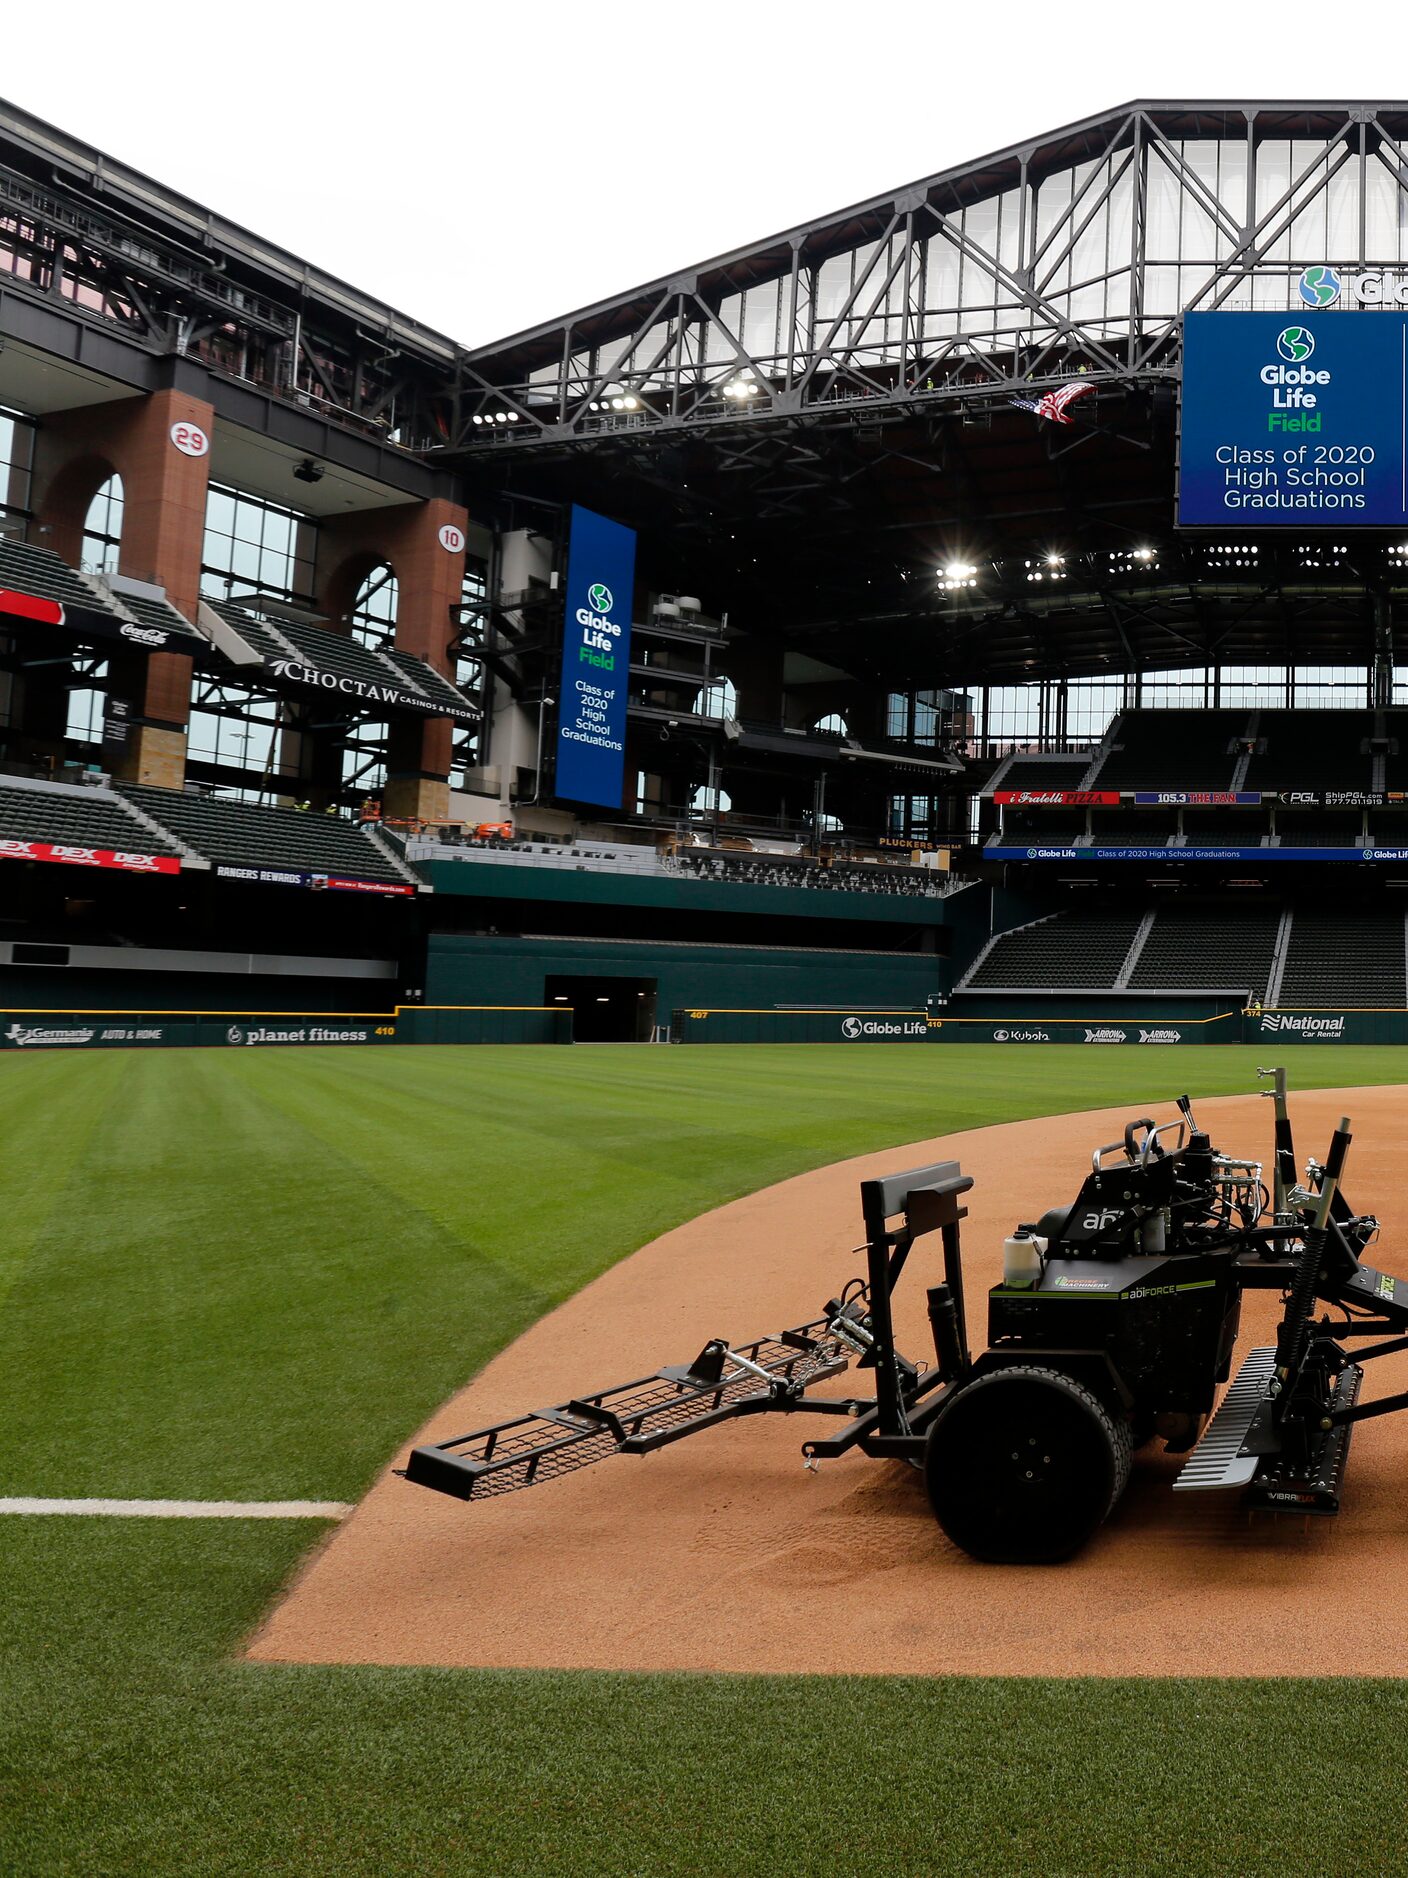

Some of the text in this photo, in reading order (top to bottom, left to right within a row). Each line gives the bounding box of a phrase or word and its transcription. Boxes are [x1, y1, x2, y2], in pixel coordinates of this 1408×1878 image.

[1260, 365, 1331, 385] Globe
[1273, 388, 1317, 408] Life
[1268, 412, 1321, 432] Field
[176, 428, 203, 451] 29
[1216, 445, 1375, 464] Class of 2020
[1225, 467, 1365, 489] High School
[1224, 489, 1366, 508] Graduations
[444, 530, 459, 547] 10
[576, 608, 622, 637] Globe
[583, 628, 613, 652] Life
[579, 647, 615, 671] Field
[284, 662, 400, 703] CHOCTAW
[446, 706, 481, 721] RESORTS
[575, 680, 616, 700] Class of
[580, 694, 608, 710] 2020
[582, 707, 606, 722] High
[576, 718, 611, 736] School
[561, 727, 623, 751] Graduations
[1158, 793, 1187, 803] 105.3
[1290, 792, 1319, 802] PGL
[880, 837, 934, 850] PLUCKERS
[50, 845, 99, 860] DEX
[112, 852, 158, 867] DEX
[1038, 849, 1061, 858] Globe
[1062, 849, 1077, 858] Life
[1098, 850, 1117, 859] Class
[1119, 850, 1127, 859] of
[1128, 850, 1148, 859] 2020
[1149, 850, 1166, 860] High
[1168, 850, 1194, 859] School
[1196, 850, 1240, 859] Graduations
[1374, 850, 1397, 859] Globe
[217, 866, 302, 884] RANGERS REWARDS
[690, 1011, 709, 1019] 407
[32, 1028, 95, 1038] Germania
[101, 1030, 126, 1039] AUTO
[136, 1030, 163, 1039] HOME
[375, 1026, 396, 1036] 410
[863, 1021, 927, 1035] Globe Life
[1010, 1030, 1051, 1041] Kubota
[1095, 1029, 1121, 1038] ARROW
[1150, 1029, 1176, 1038] ARROW
[1317, 1030, 1342, 1038] Rental
[246, 1028, 367, 1045] planet fitness
